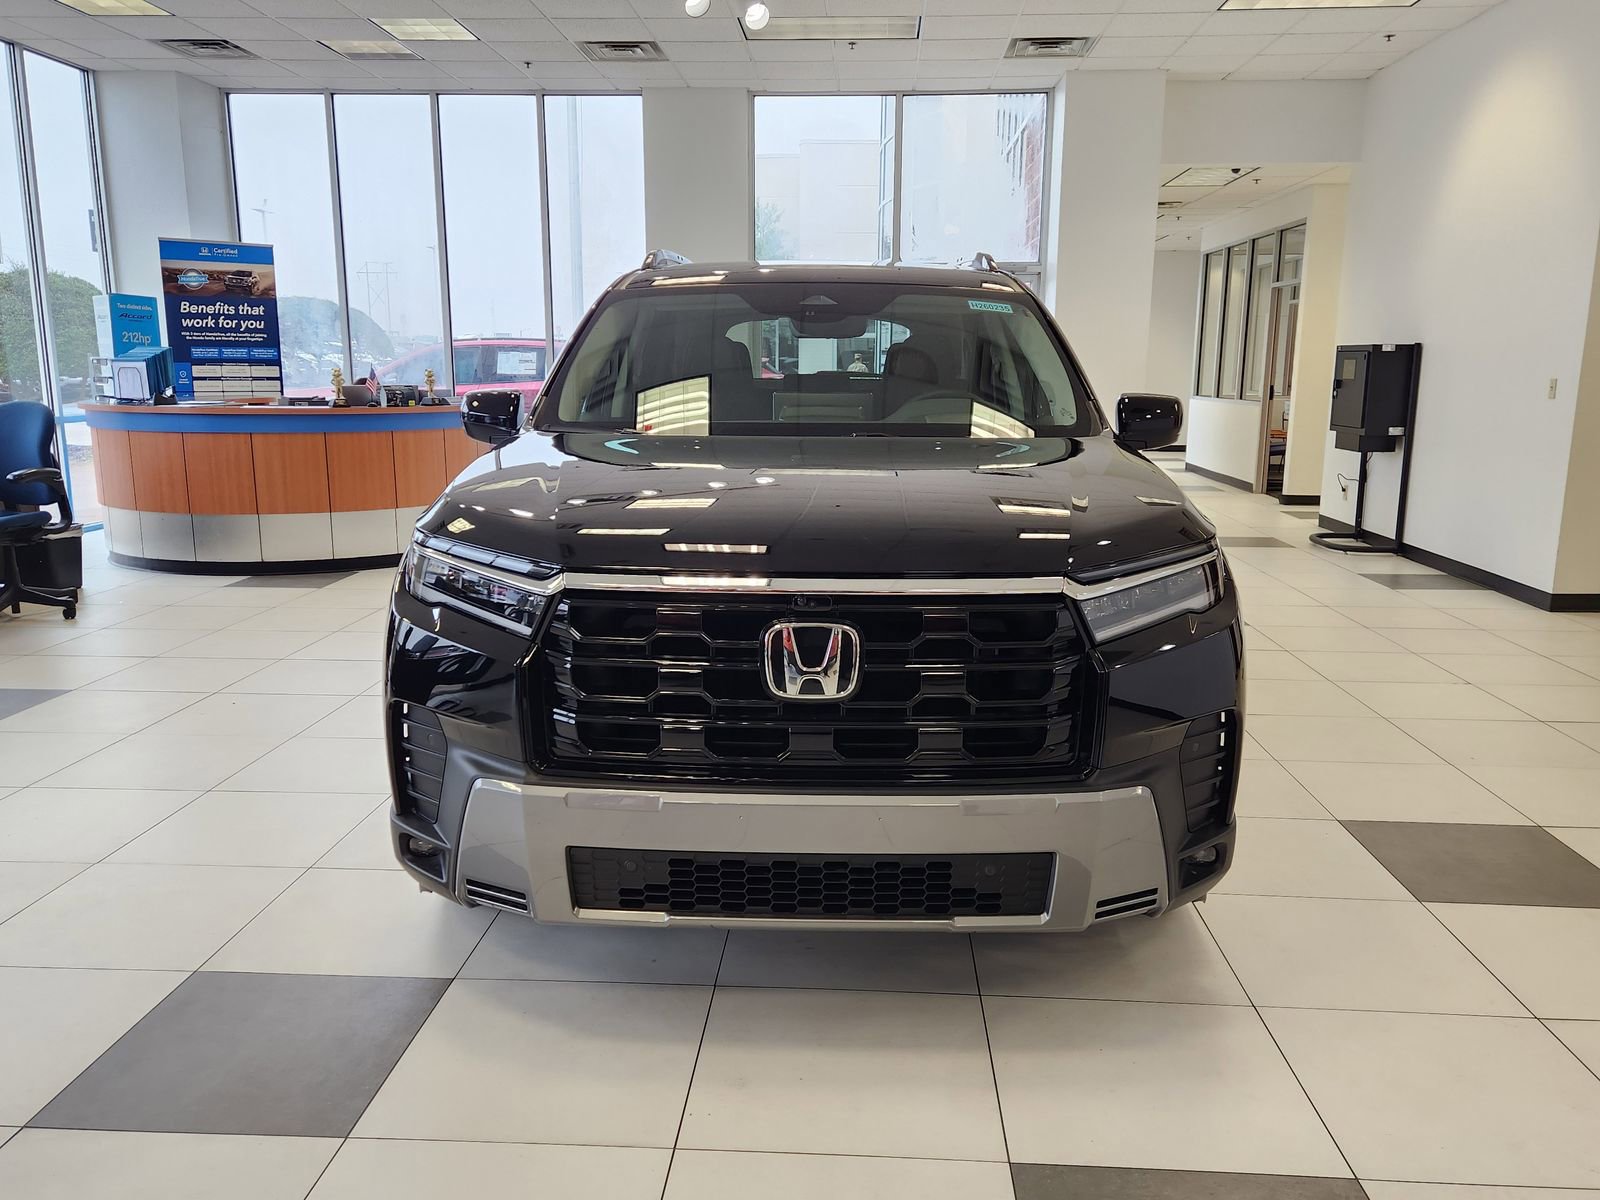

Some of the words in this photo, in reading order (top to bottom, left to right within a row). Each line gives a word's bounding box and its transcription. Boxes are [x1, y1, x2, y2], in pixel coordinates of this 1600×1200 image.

[180, 302, 235, 315] Benefits
[239, 303, 265, 316] that
[970, 301, 1011, 312] H260235
[118, 312, 152, 320] Accord
[181, 316, 216, 328] work
[218, 316, 238, 328] for
[240, 320, 265, 332] you
[122, 330, 152, 346] 212hp
